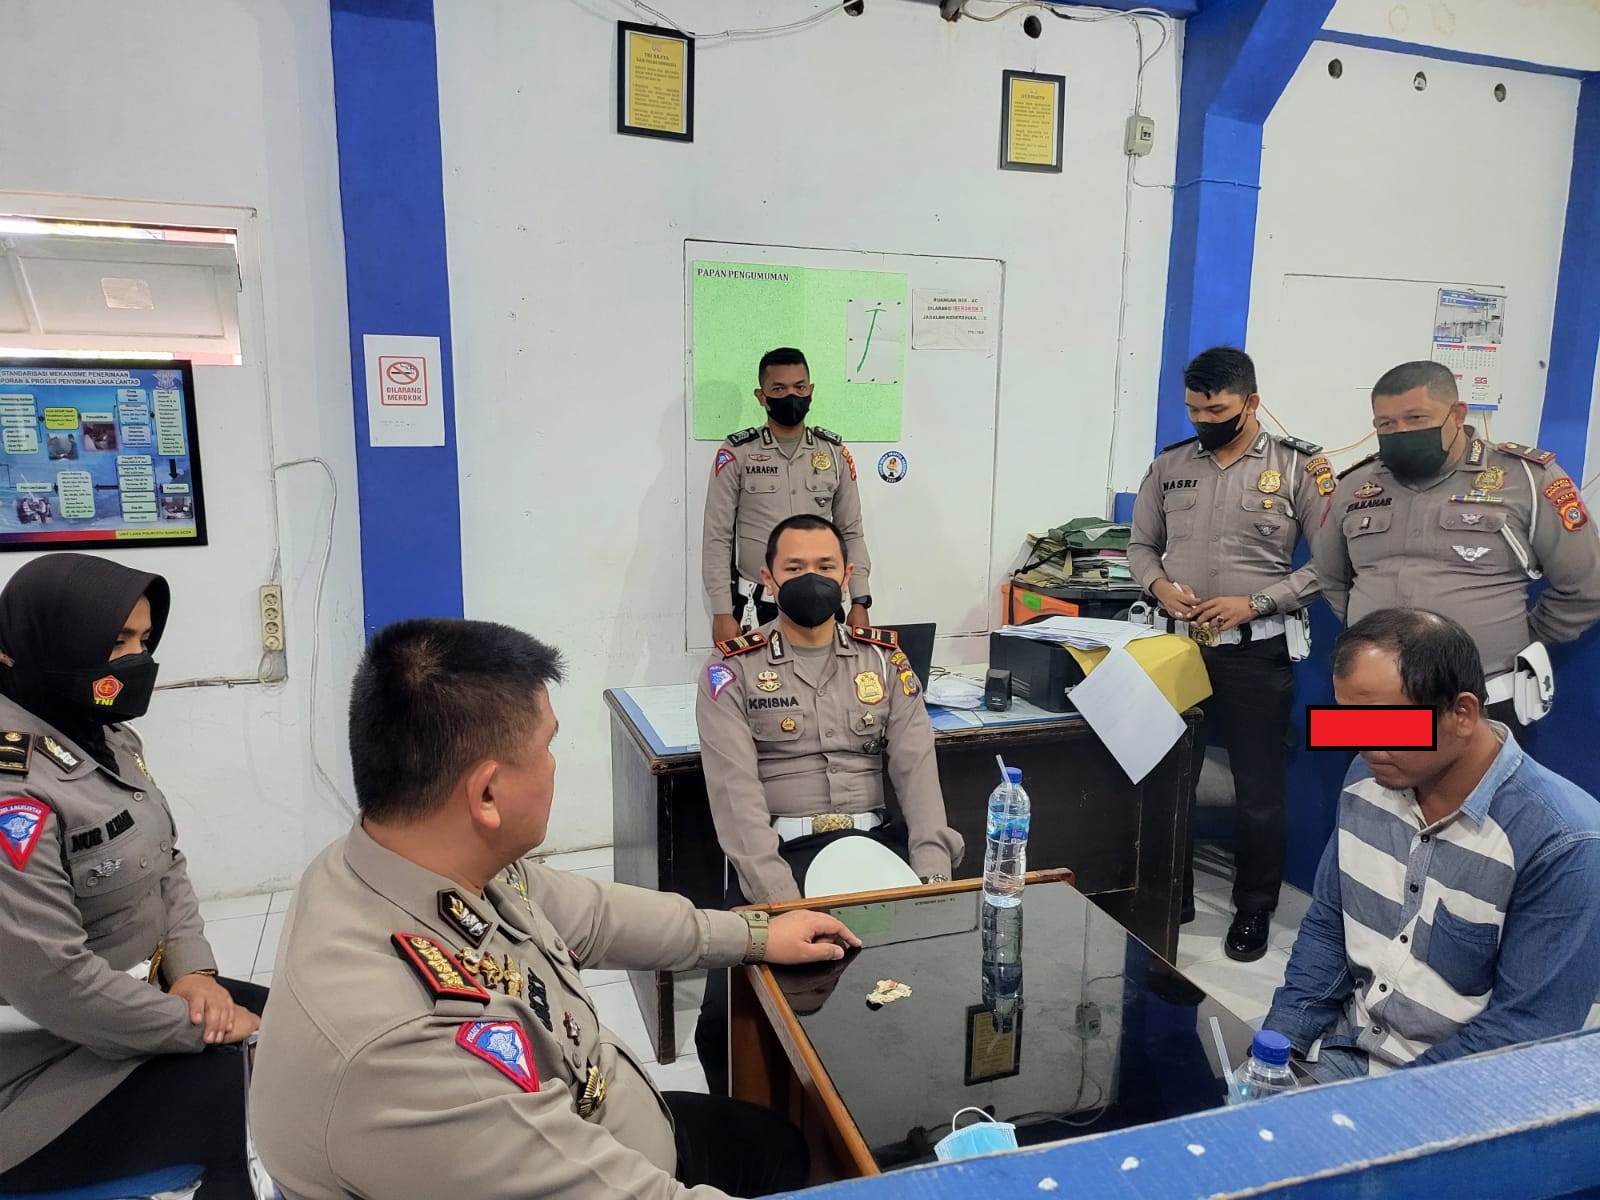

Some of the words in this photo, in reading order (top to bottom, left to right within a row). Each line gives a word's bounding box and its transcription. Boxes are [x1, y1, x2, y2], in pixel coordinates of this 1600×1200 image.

[697, 268, 726, 278] PAPAN
[728, 270, 789, 281] PENGUMUMAN
[95, 698, 114, 706] TNI
